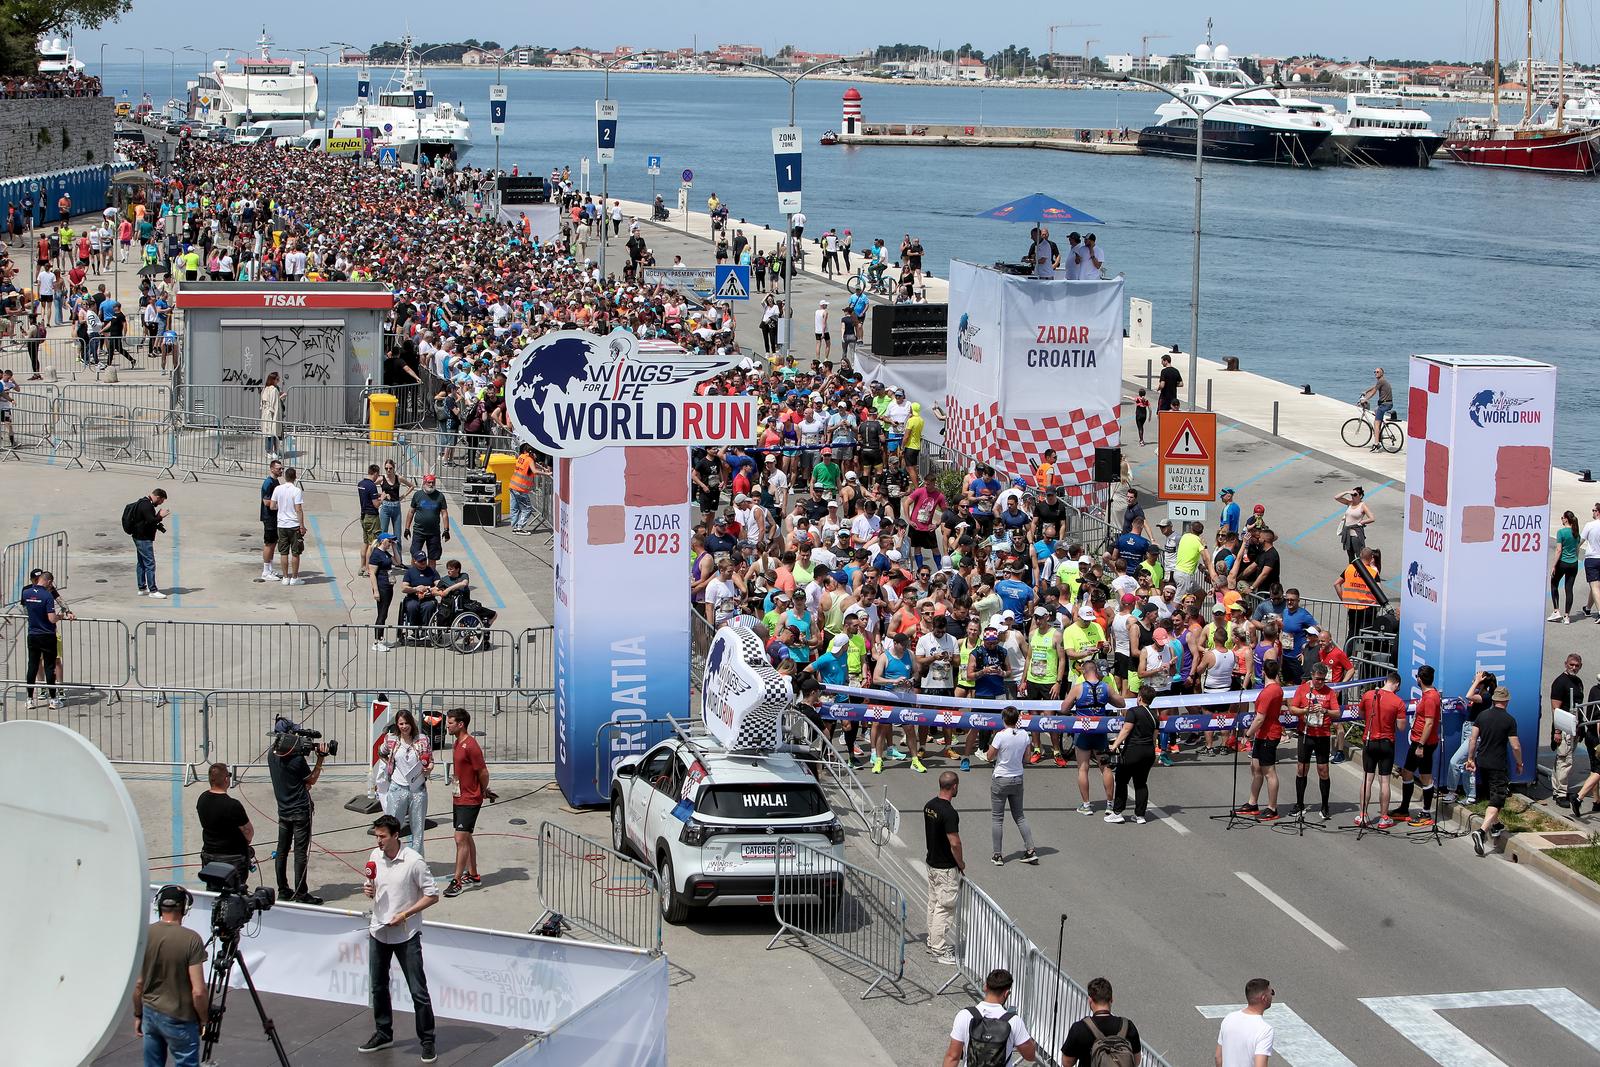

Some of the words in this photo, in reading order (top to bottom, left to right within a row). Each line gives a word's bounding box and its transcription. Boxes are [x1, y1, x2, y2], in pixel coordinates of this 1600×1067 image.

[495, 107, 501, 117] 3
[603, 128, 610, 140] 2
[778, 133, 797, 142] ZONA
[329, 139, 362, 150] KEINDL
[785, 164, 792, 181] 1
[264, 294, 306, 307] TISAK
[1036, 325, 1090, 344] ZADAR
[1027, 349, 1097, 368] CROATIA
[589, 364, 674, 383] WINGS
[583, 383, 602, 392] FOR
[600, 383, 648, 401] LIFE
[554, 402, 677, 440] WORLD
[682, 402, 750, 440] RUN
[1483, 411, 1519, 423] WORLD
[1520, 411, 1541, 423] RUN
[1168, 467, 1205, 475] ULAZ/IZLAZ
[1171, 475, 1193, 483] VOZILA
[1175, 506, 1188, 516] 50
[1190, 508, 1199, 516] m
[634, 514, 680, 531] ZADAR
[1426, 510, 1443, 530] ZADAR
[1502, 514, 1542, 530] ZADAR
[633, 533, 680, 555] 2023
[1425, 528, 1443, 552] 2023
[1501, 532, 1541, 552] 2023
[558, 628, 566, 764] CROATIA
[743, 793, 788, 808] HVALA!
[745, 846, 776, 855] CATCHER
